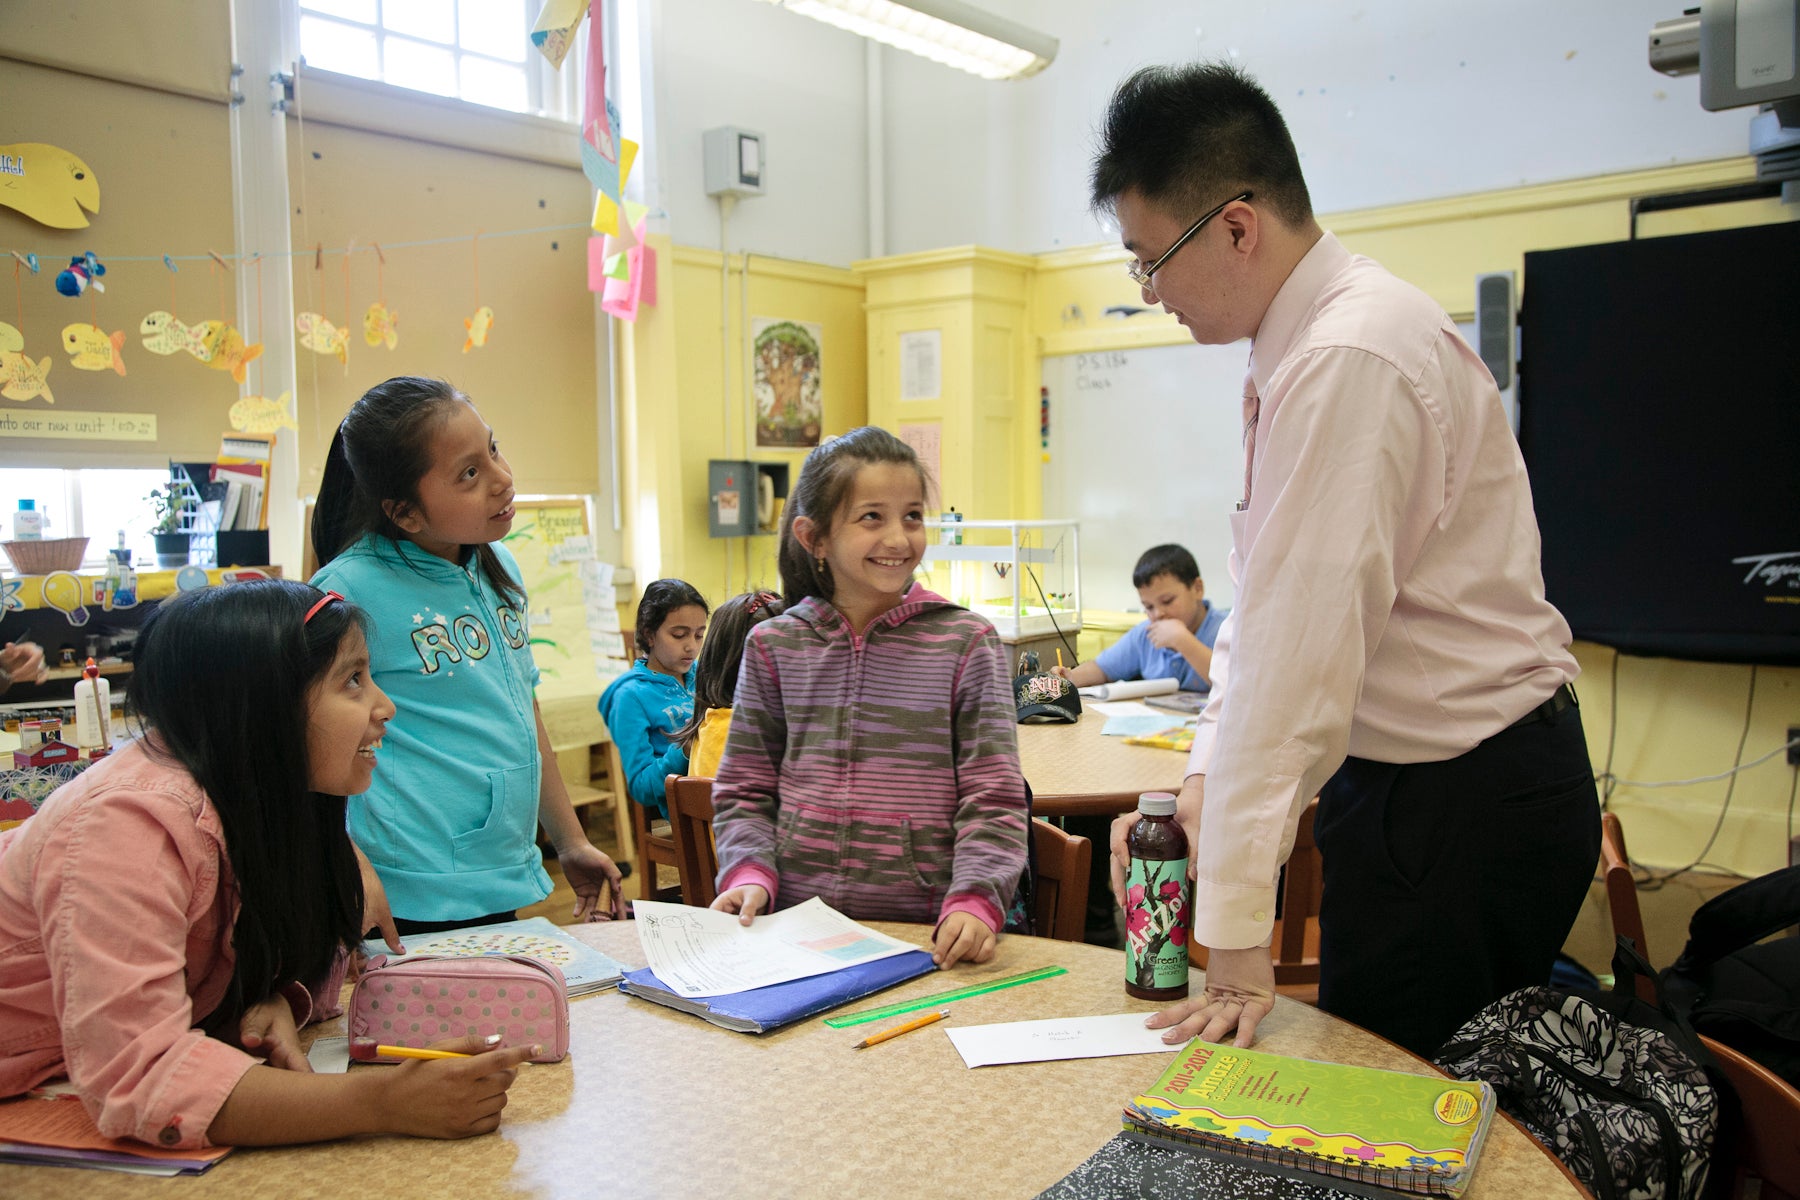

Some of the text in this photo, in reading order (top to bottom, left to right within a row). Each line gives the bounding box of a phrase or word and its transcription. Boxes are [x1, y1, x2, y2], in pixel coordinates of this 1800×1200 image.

[23, 420, 42, 430] our
[49, 421, 69, 432] new
[1149, 953, 1178, 966] Green
[1164, 1048, 1215, 1095] 2011-2012
[1188, 1055, 1240, 1100] Amaze
